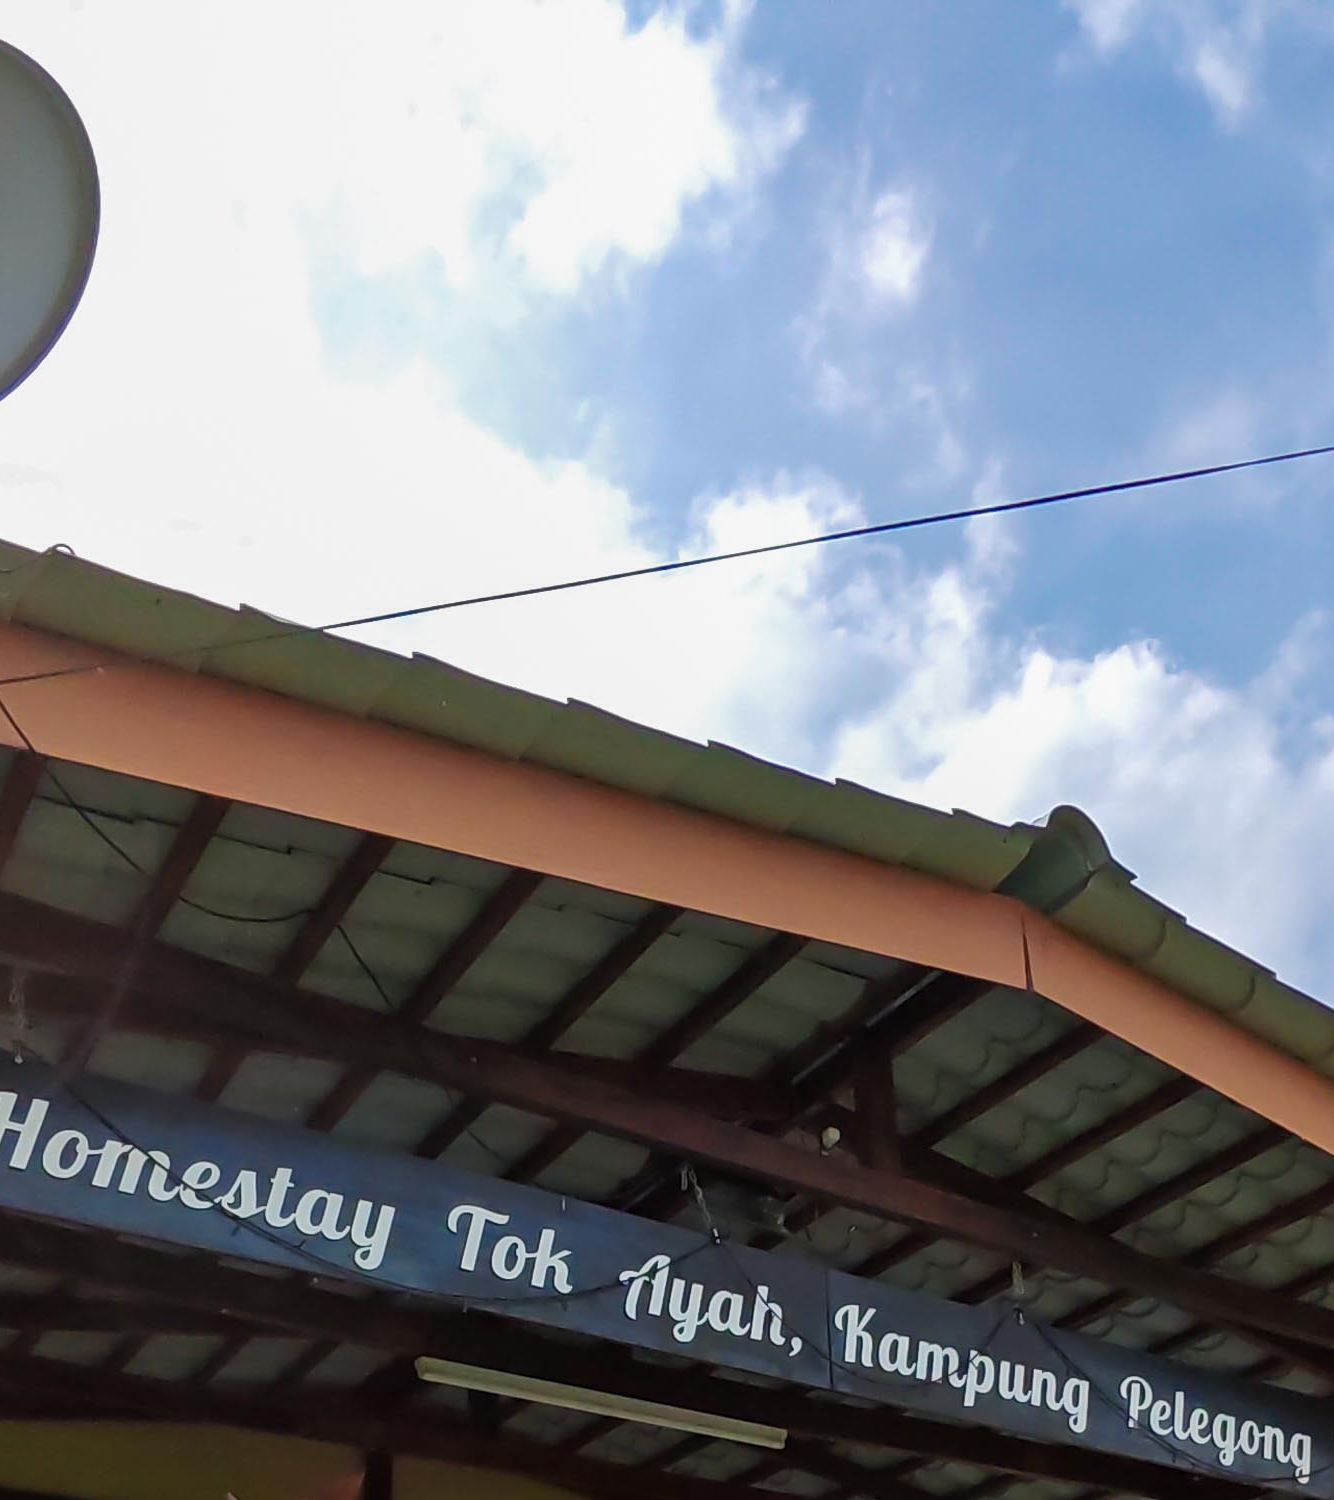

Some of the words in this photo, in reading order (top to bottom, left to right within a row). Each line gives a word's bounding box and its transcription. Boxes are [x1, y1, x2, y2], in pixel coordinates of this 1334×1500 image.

[447, 1204, 573, 1294] Tok
[619, 1254, 803, 1358] Ayah,
[834, 1304, 1090, 1434] Kampung
[1120, 1375, 1312, 1485] Pelegong
